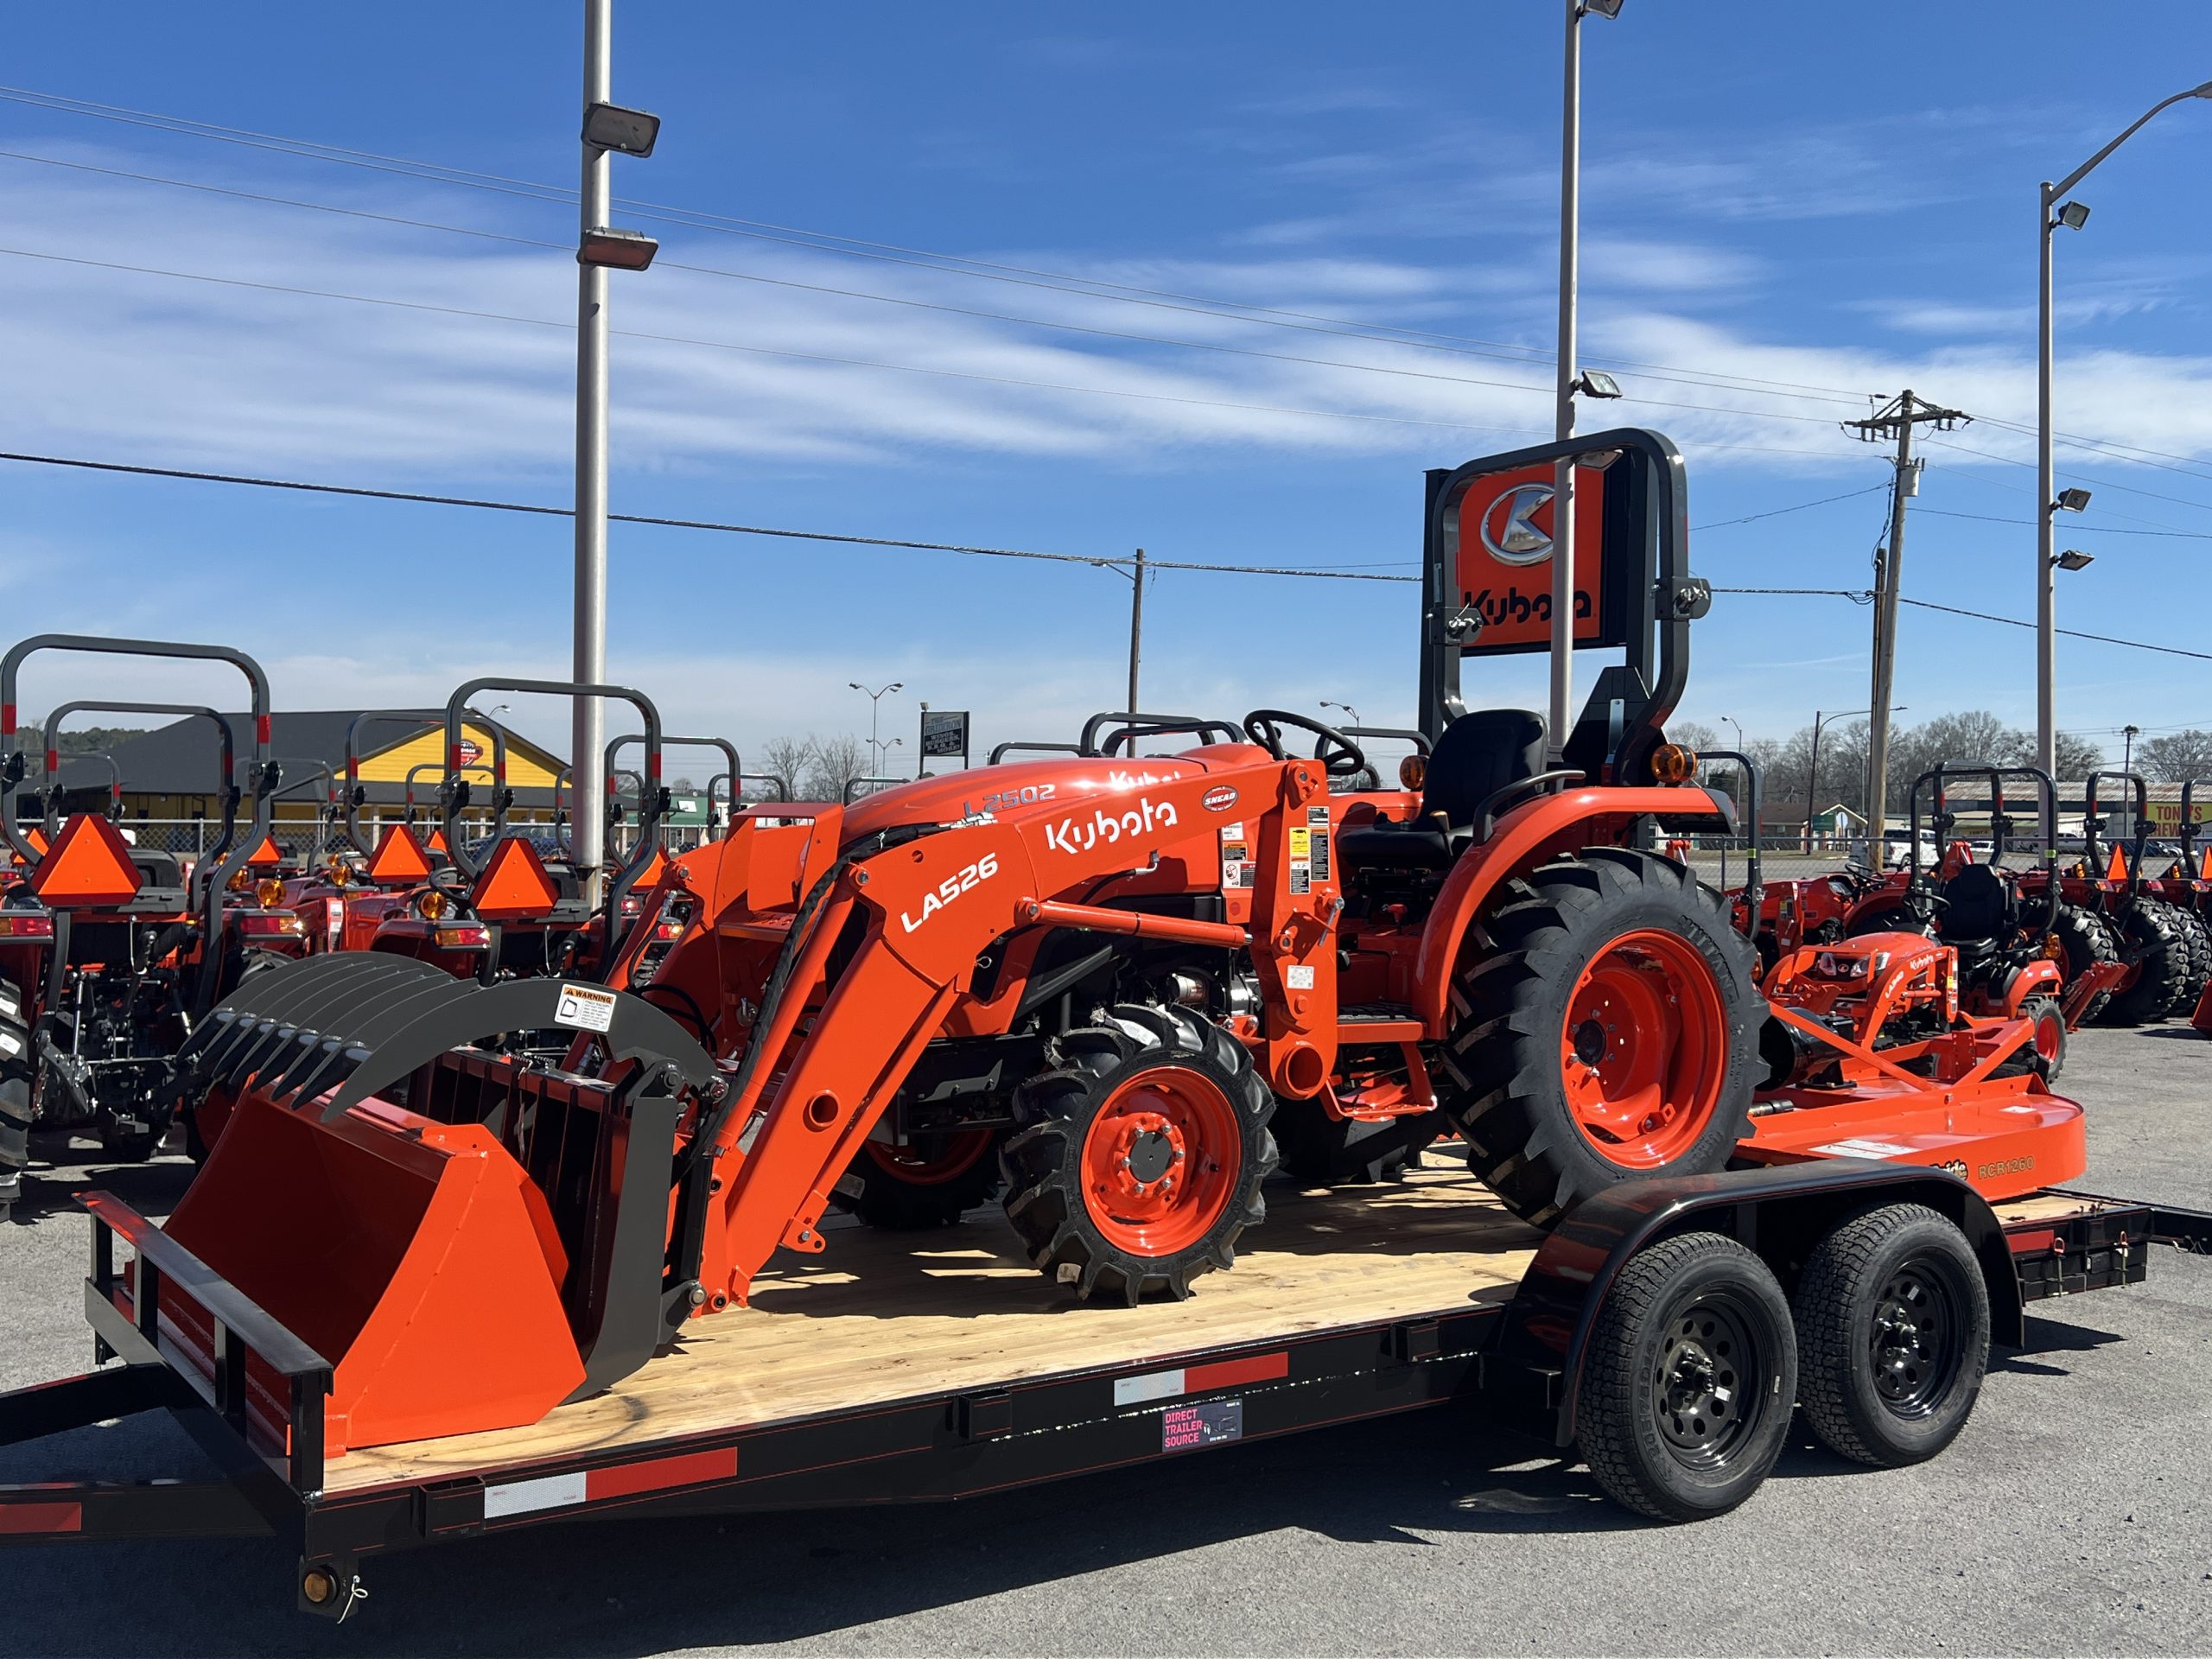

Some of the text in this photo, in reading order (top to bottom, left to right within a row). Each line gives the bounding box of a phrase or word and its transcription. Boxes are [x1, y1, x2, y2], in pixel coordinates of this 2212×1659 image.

[1465, 587, 1592, 626] Kuboa
[963, 784, 1056, 818] L2502
[1205, 792, 1236, 805] SNEAD
[2157, 805, 2202, 821] TON'S
[1045, 798, 1178, 855] Kubota
[900, 852, 998, 933] LA526
[1910, 953, 1935, 970] Kubota
[575, 989, 612, 1003] WARNING
[1978, 1156, 2035, 1180] RCR1260
[1165, 1408, 1198, 1424] DIRECT
[1165, 1420, 1203, 1436] TRAILER
[1165, 1432, 1199, 1447] SOURCE
